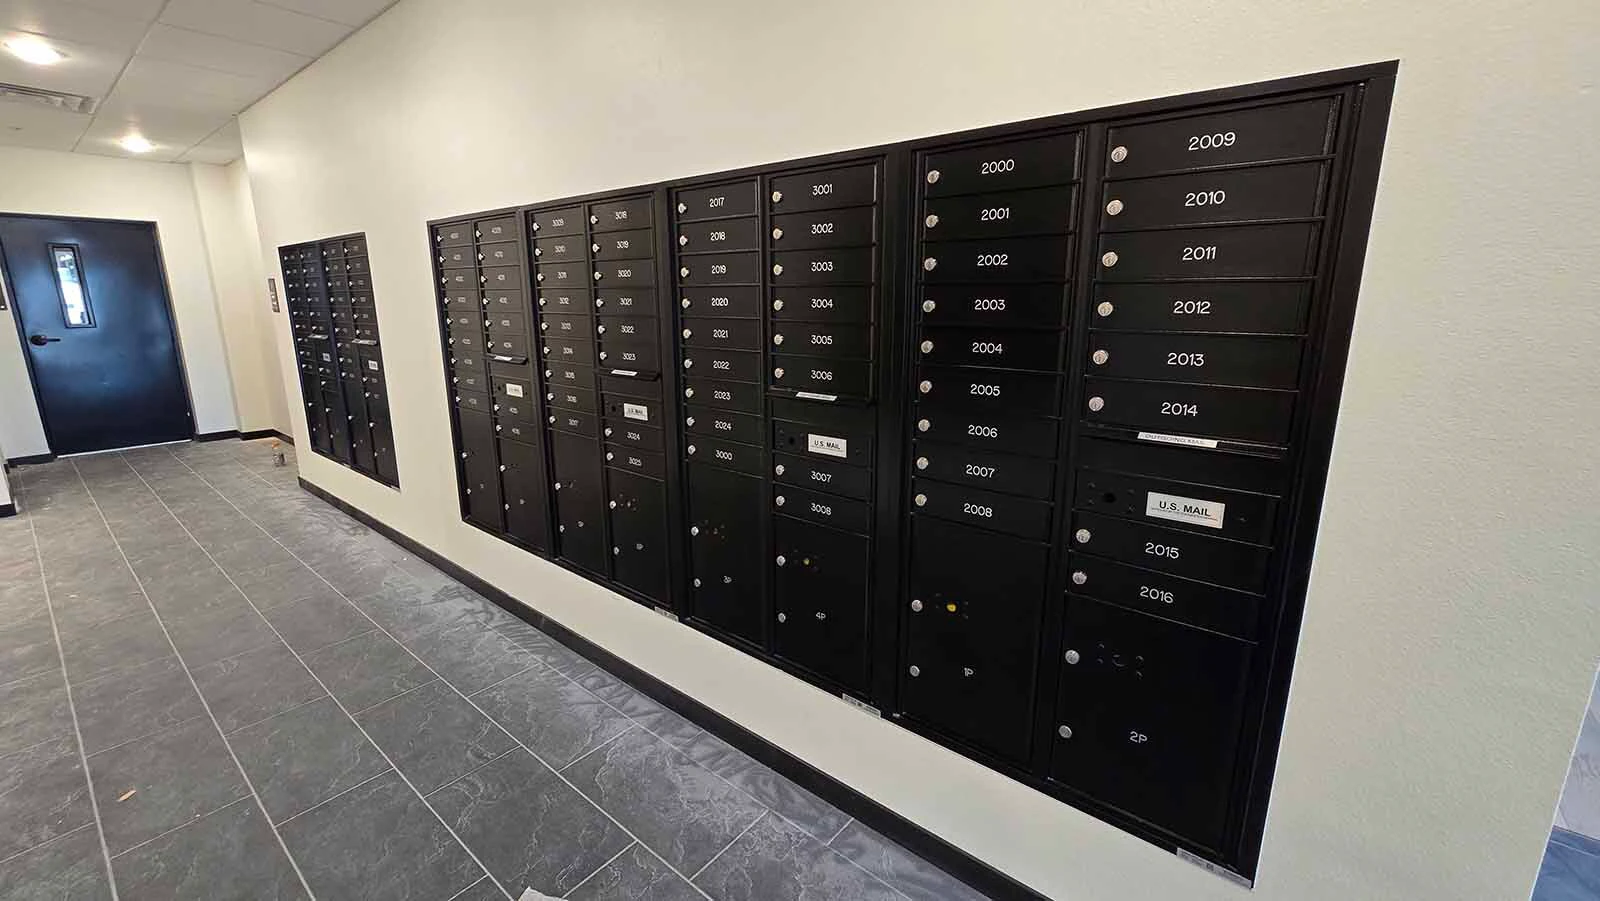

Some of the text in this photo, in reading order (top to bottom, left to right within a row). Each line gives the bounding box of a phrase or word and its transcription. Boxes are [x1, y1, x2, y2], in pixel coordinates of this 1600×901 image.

[1188, 131, 1236, 151] 2009
[981, 158, 1015, 175] 2000
[812, 183, 833, 196] 3001
[709, 196, 725, 208] 2017
[1184, 190, 1226, 207] 2010
[980, 207, 1010, 221] 2001
[810, 222, 834, 235] 3002
[710, 231, 726, 242] 2018
[976, 253, 1009, 267] 2002
[1182, 246, 1217, 261] 2011
[711, 264, 727, 275] 2019
[810, 261, 834, 272] 3003
[617, 269, 632, 278] 3020
[711, 297, 729, 307] 2020
[810, 298, 834, 309] 3004
[974, 298, 1006, 311] 2003
[1173, 300, 1211, 315] 2012
[620, 325, 635, 334] 3022
[713, 328, 729, 339] 2021
[810, 334, 833, 345] 3005
[972, 341, 1003, 354] 2004
[622, 352, 637, 361] 3023
[1167, 352, 1205, 367] 2013
[712, 360, 730, 370] 2022
[810, 369, 833, 381] 3006
[713, 390, 731, 401] 2023
[970, 383, 1001, 397] 2005
[1160, 401, 1199, 417] 2014
[714, 420, 732, 431] 2024
[967, 424, 998, 438] 2006
[715, 449, 733, 461] 3000
[810, 470, 832, 483] 3007
[965, 464, 996, 478] 2007
[810, 502, 832, 516] 3008
[963, 502, 993, 518] 2008
[1159, 500, 1180, 512] U.S.
[1182, 504, 1212, 517] MAIL
[1145, 542, 1180, 560] 2015
[1139, 585, 1174, 604] 2016
[815, 611, 827, 621] 4P
[1129, 730, 1148, 744] 2P
